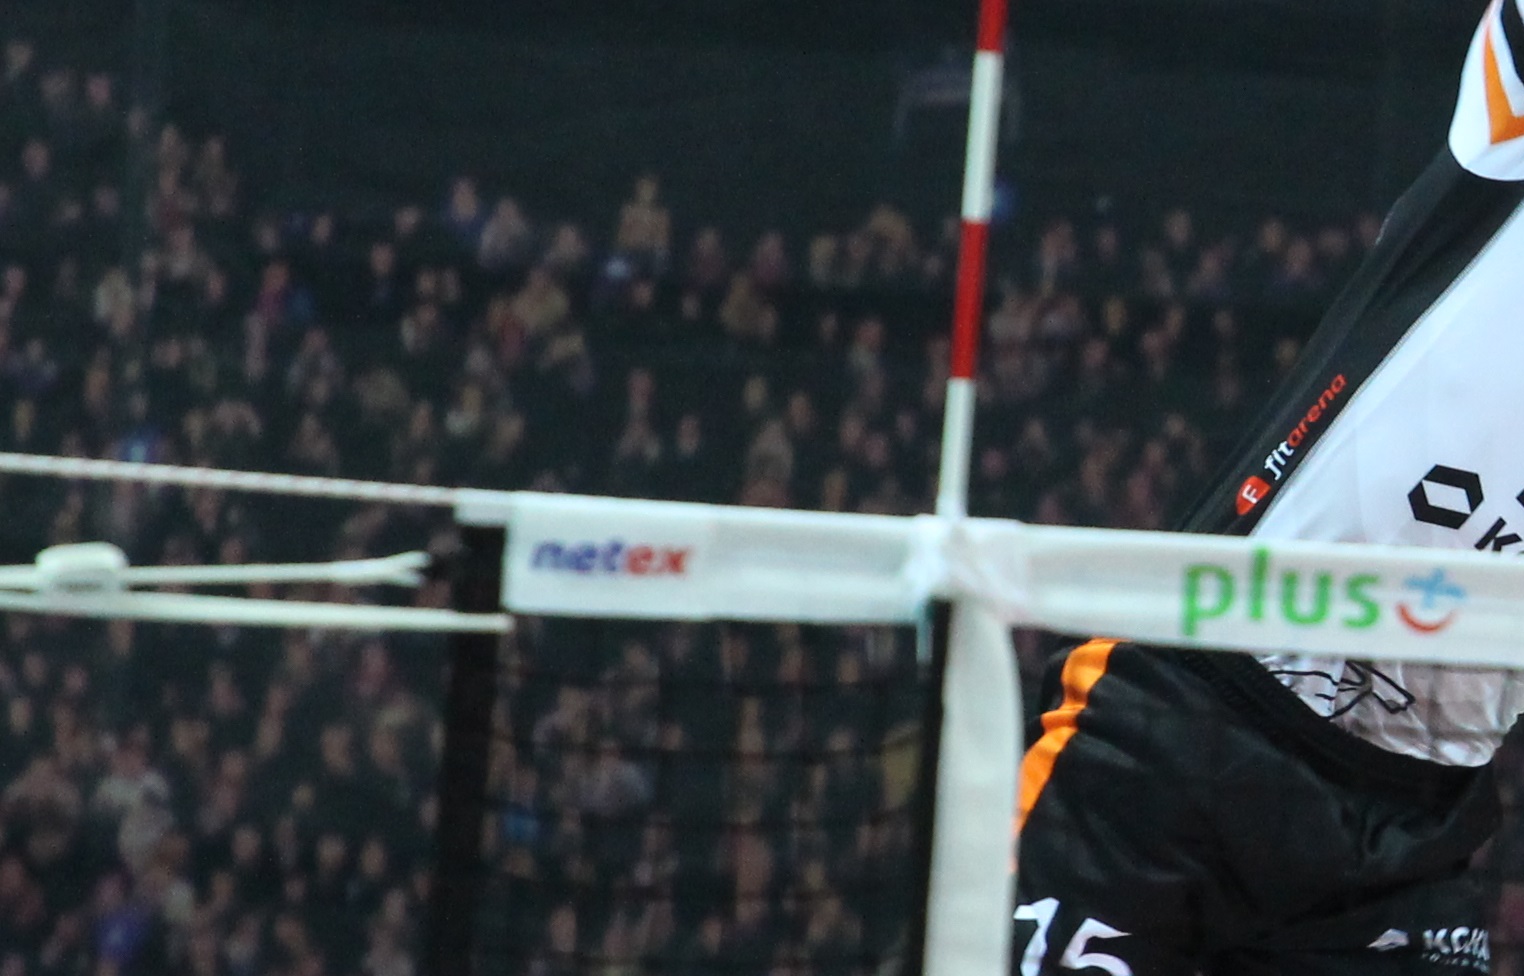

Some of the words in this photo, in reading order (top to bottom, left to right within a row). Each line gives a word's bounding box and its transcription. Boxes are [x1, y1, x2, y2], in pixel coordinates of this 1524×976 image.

[1264, 374, 1348, 480] fitarena
[530, 537, 694, 576] netex
[1181, 546, 1383, 636] plus
